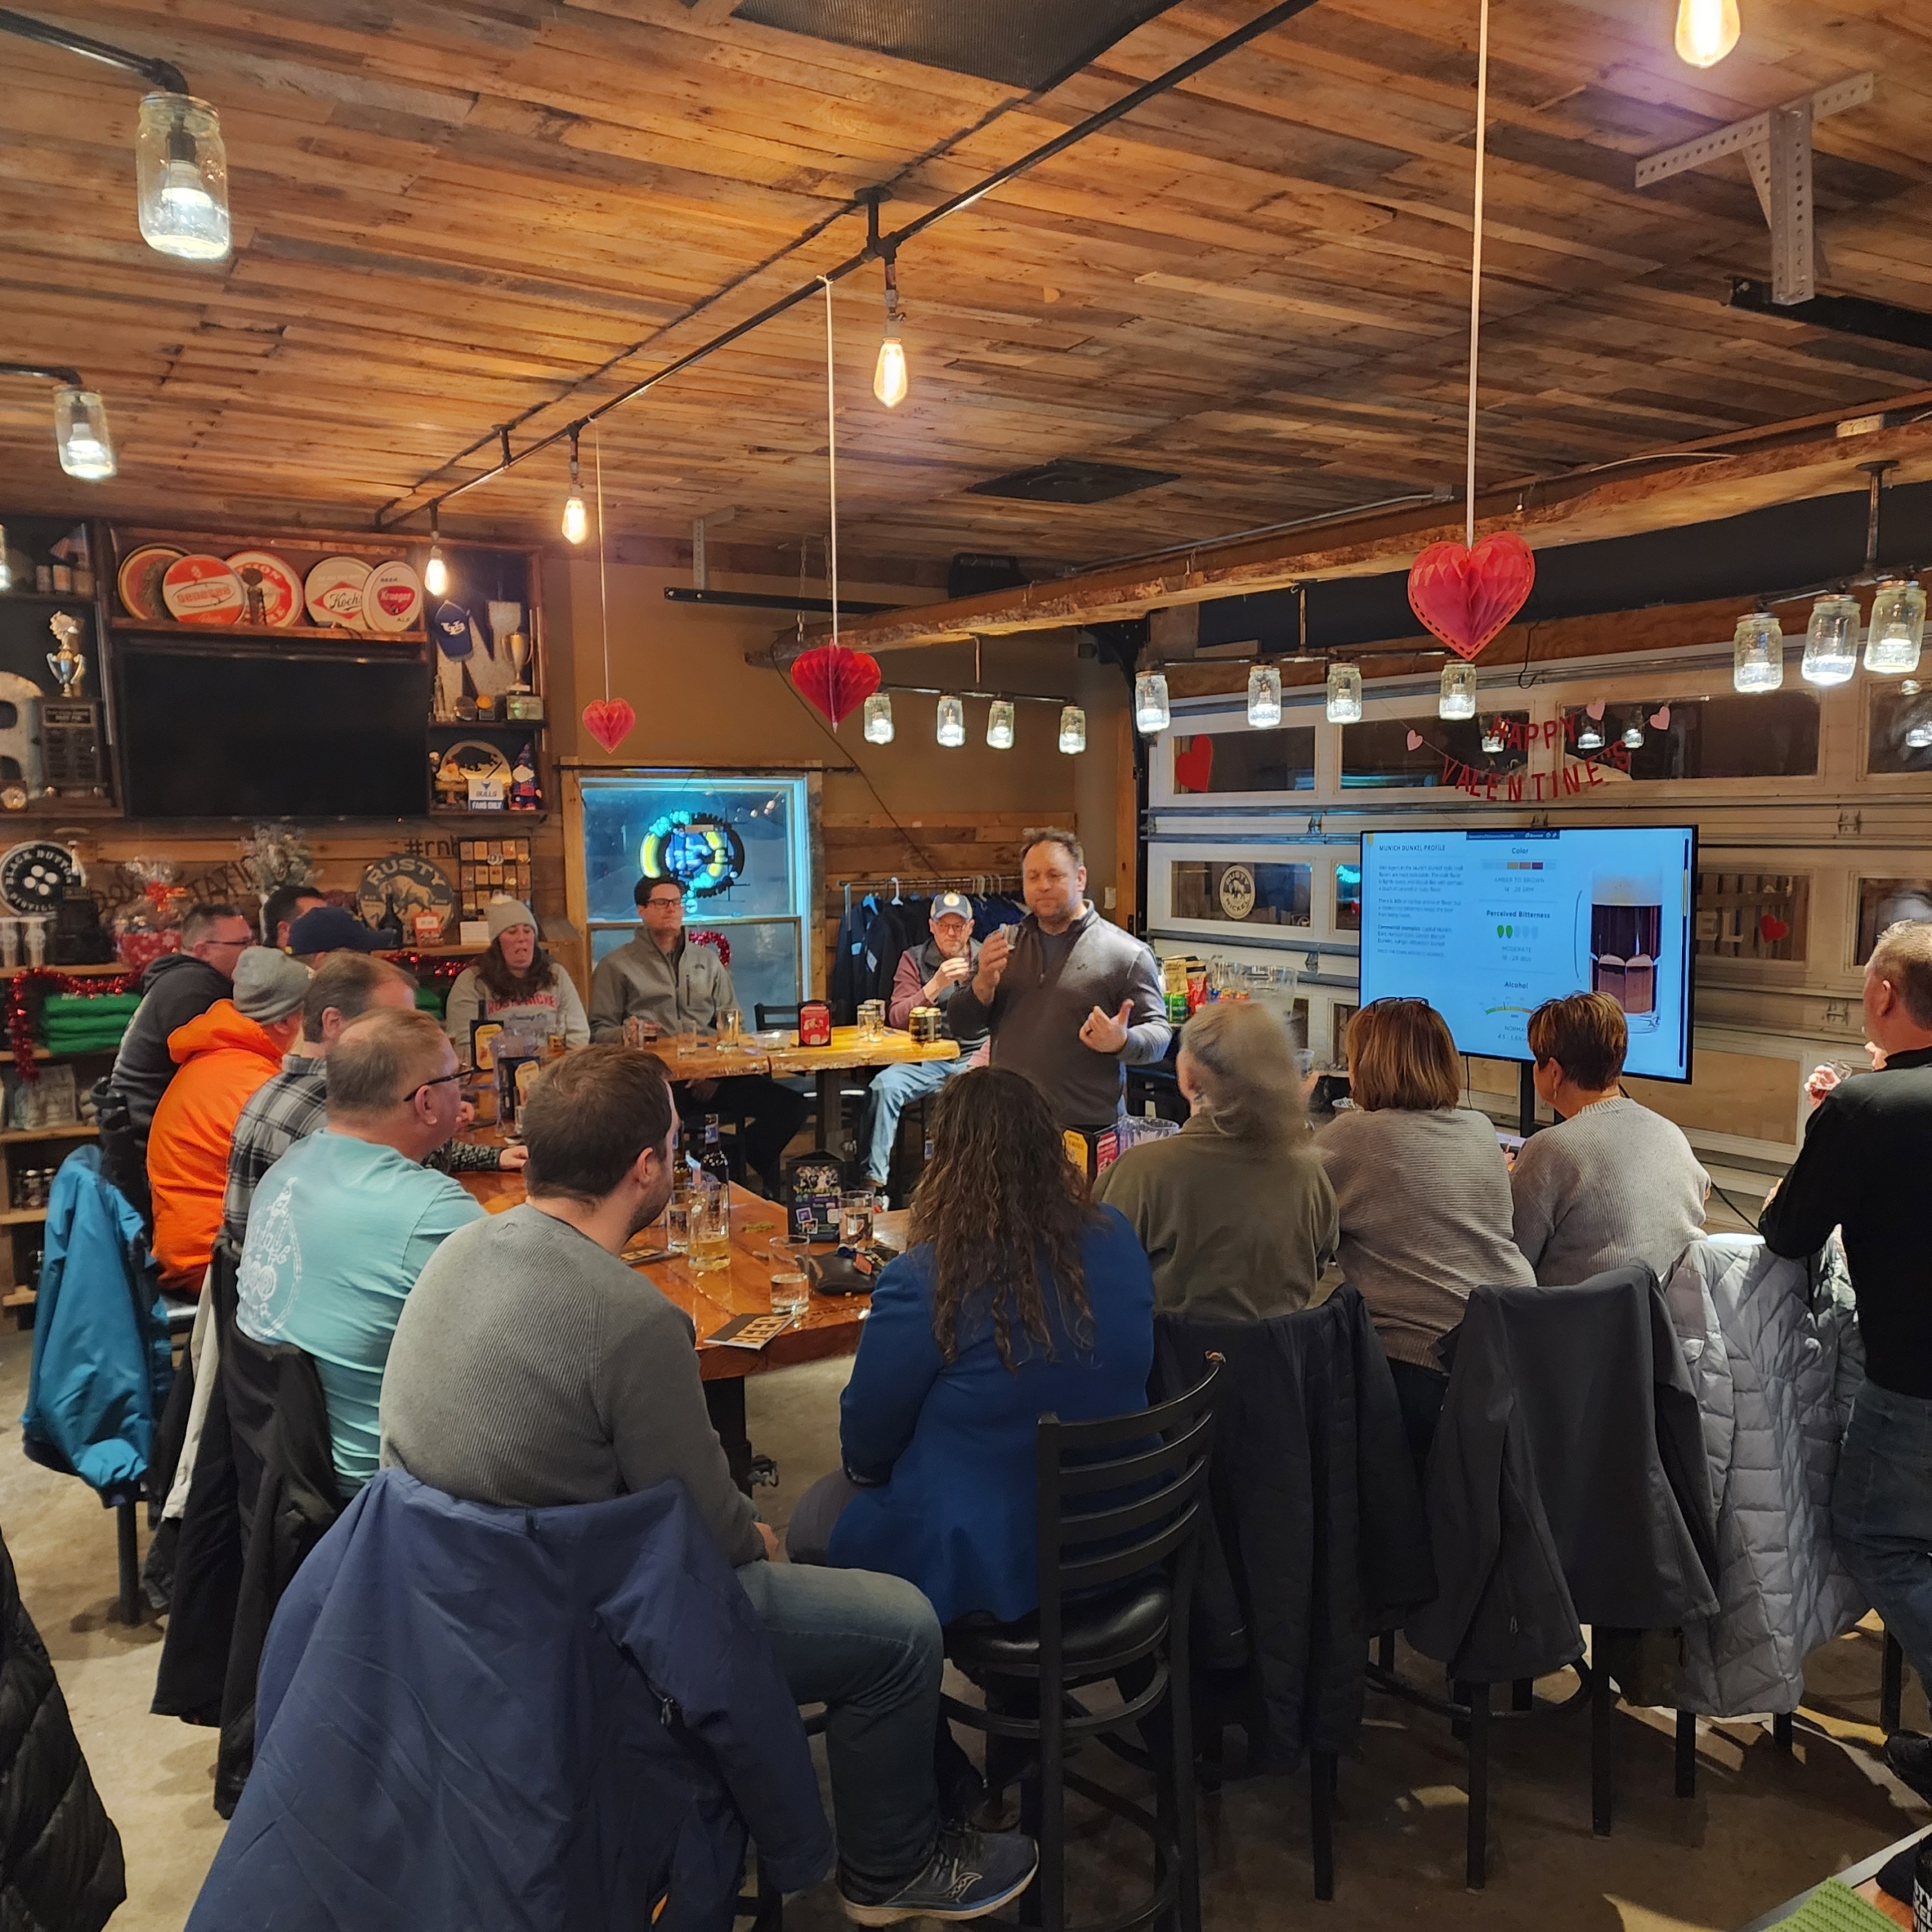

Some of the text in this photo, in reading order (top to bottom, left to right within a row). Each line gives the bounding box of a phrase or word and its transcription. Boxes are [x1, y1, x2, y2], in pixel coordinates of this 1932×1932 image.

[380, 589, 413, 603] Krueger
[1489, 712, 1577, 752] HAPPY
[1441, 740, 1631, 803] VALENTINE'S
[367, 858, 446, 887] RUSTY
[1226, 871, 1249, 885] RUSTY
[1226, 897, 1250, 912] NICKEL
[1486, 909, 1517, 918] Perceived
[1504, 981, 1528, 989] Alcohol
[728, 1314, 793, 1344] BEER
